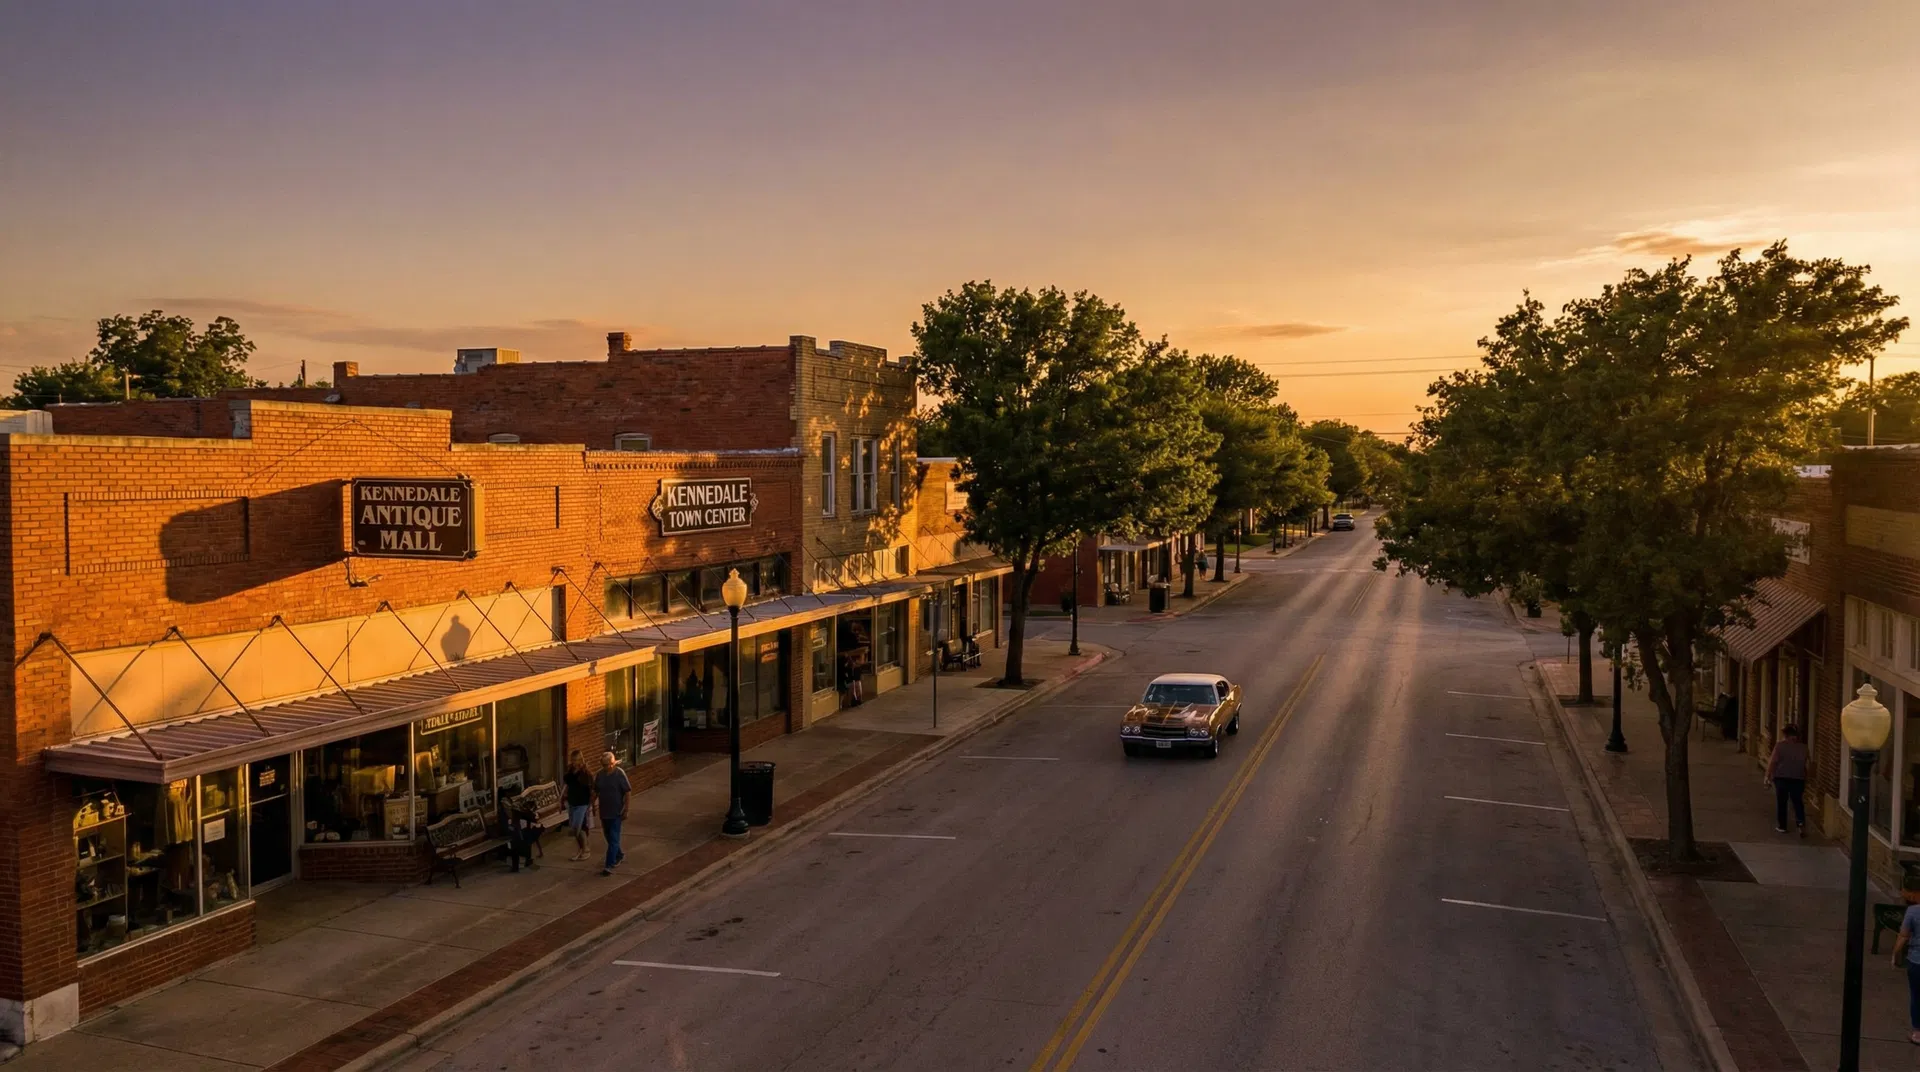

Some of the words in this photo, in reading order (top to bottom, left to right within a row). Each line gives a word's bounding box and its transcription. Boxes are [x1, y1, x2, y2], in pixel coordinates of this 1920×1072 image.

[360, 486, 461, 502] KENNEDALE
[667, 484, 748, 507] KENNEDALE
[360, 505, 462, 530] ANTIQUE
[669, 509, 702, 528] TOWN
[705, 507, 746, 525] CENTER
[380, 530, 443, 551] MALL
